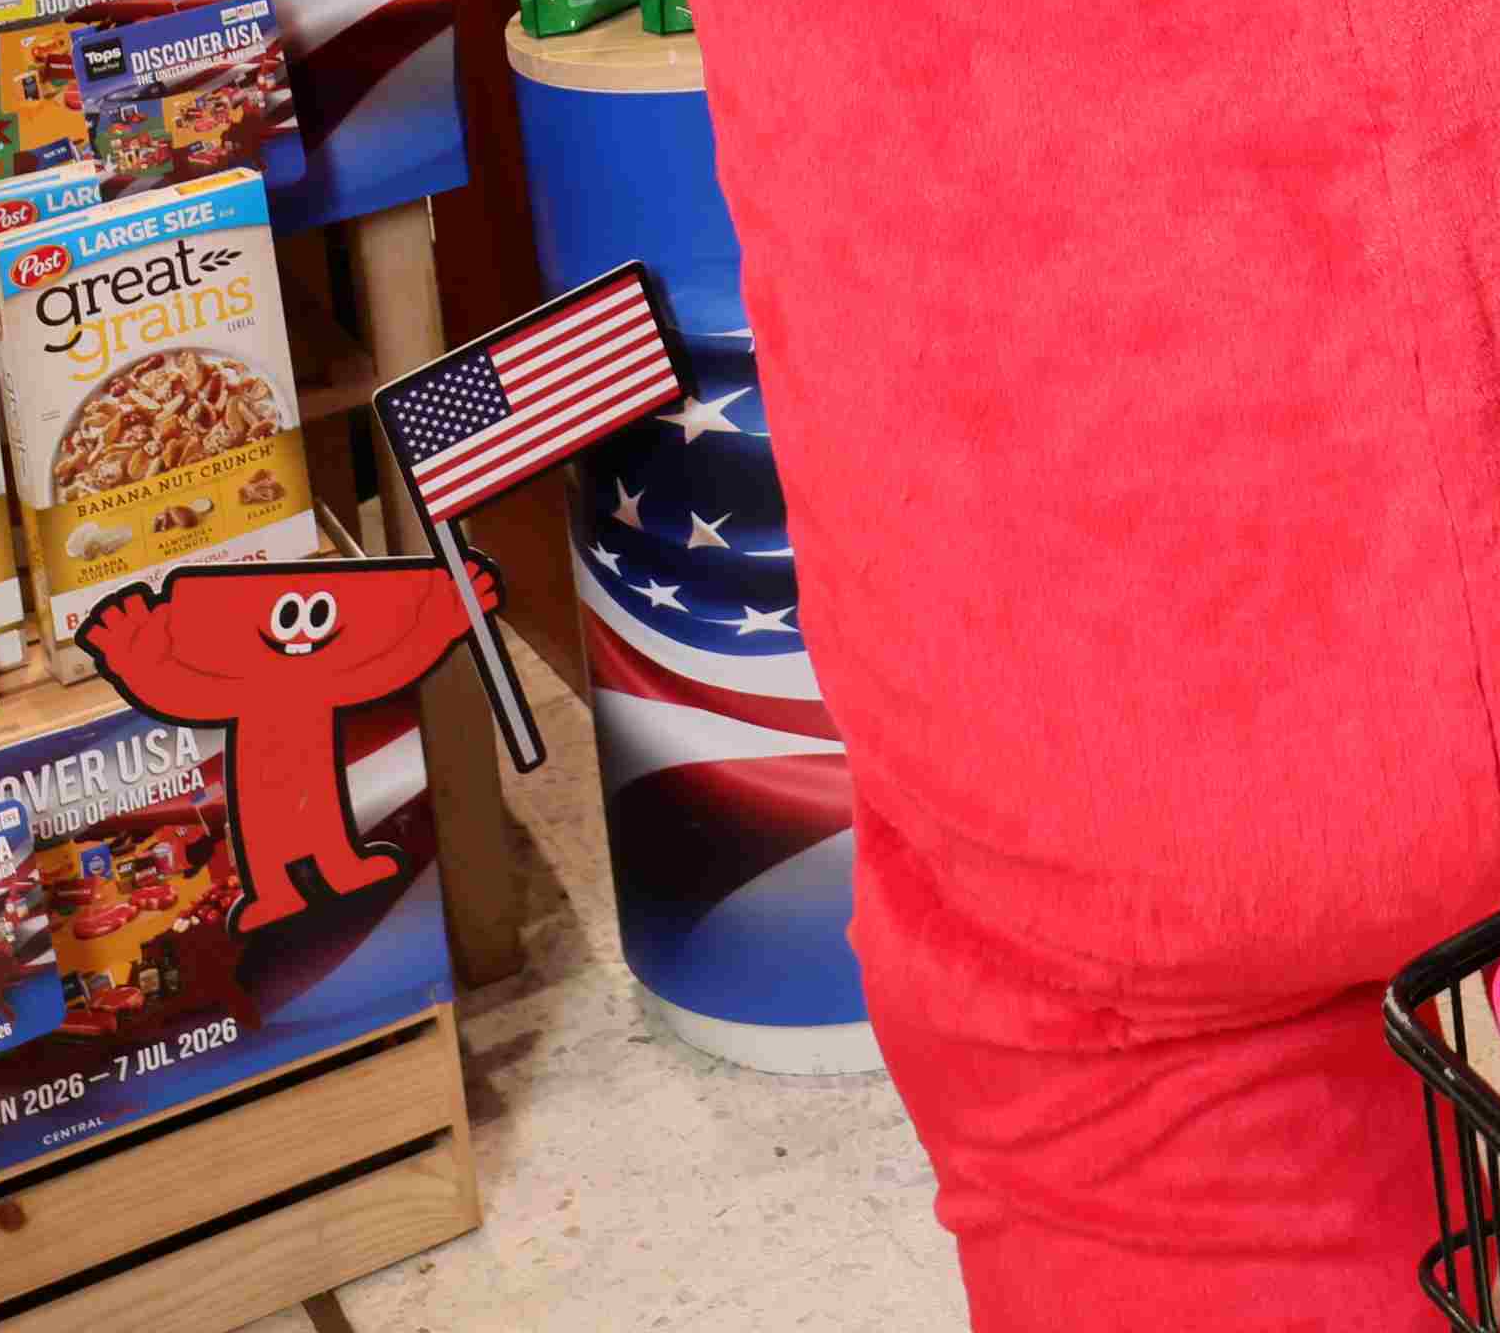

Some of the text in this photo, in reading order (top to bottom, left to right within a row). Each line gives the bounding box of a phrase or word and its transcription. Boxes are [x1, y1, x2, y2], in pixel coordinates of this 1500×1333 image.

[84, 47, 122, 66] Tops
[131, 22, 264, 74] DISCOVER USA
[79, 201, 215, 257] LARGE SIZE
[36, 239, 202, 353] great
[67, 276, 256, 382] grains
[76, 472, 195, 518] BANANA NUT
[84, 768, 204, 824] OF AMERICA
[23, 1072, 85, 1116] 2026
[113, 1055, 129, 1082] 7
[135, 1043, 175, 1076] JUL
